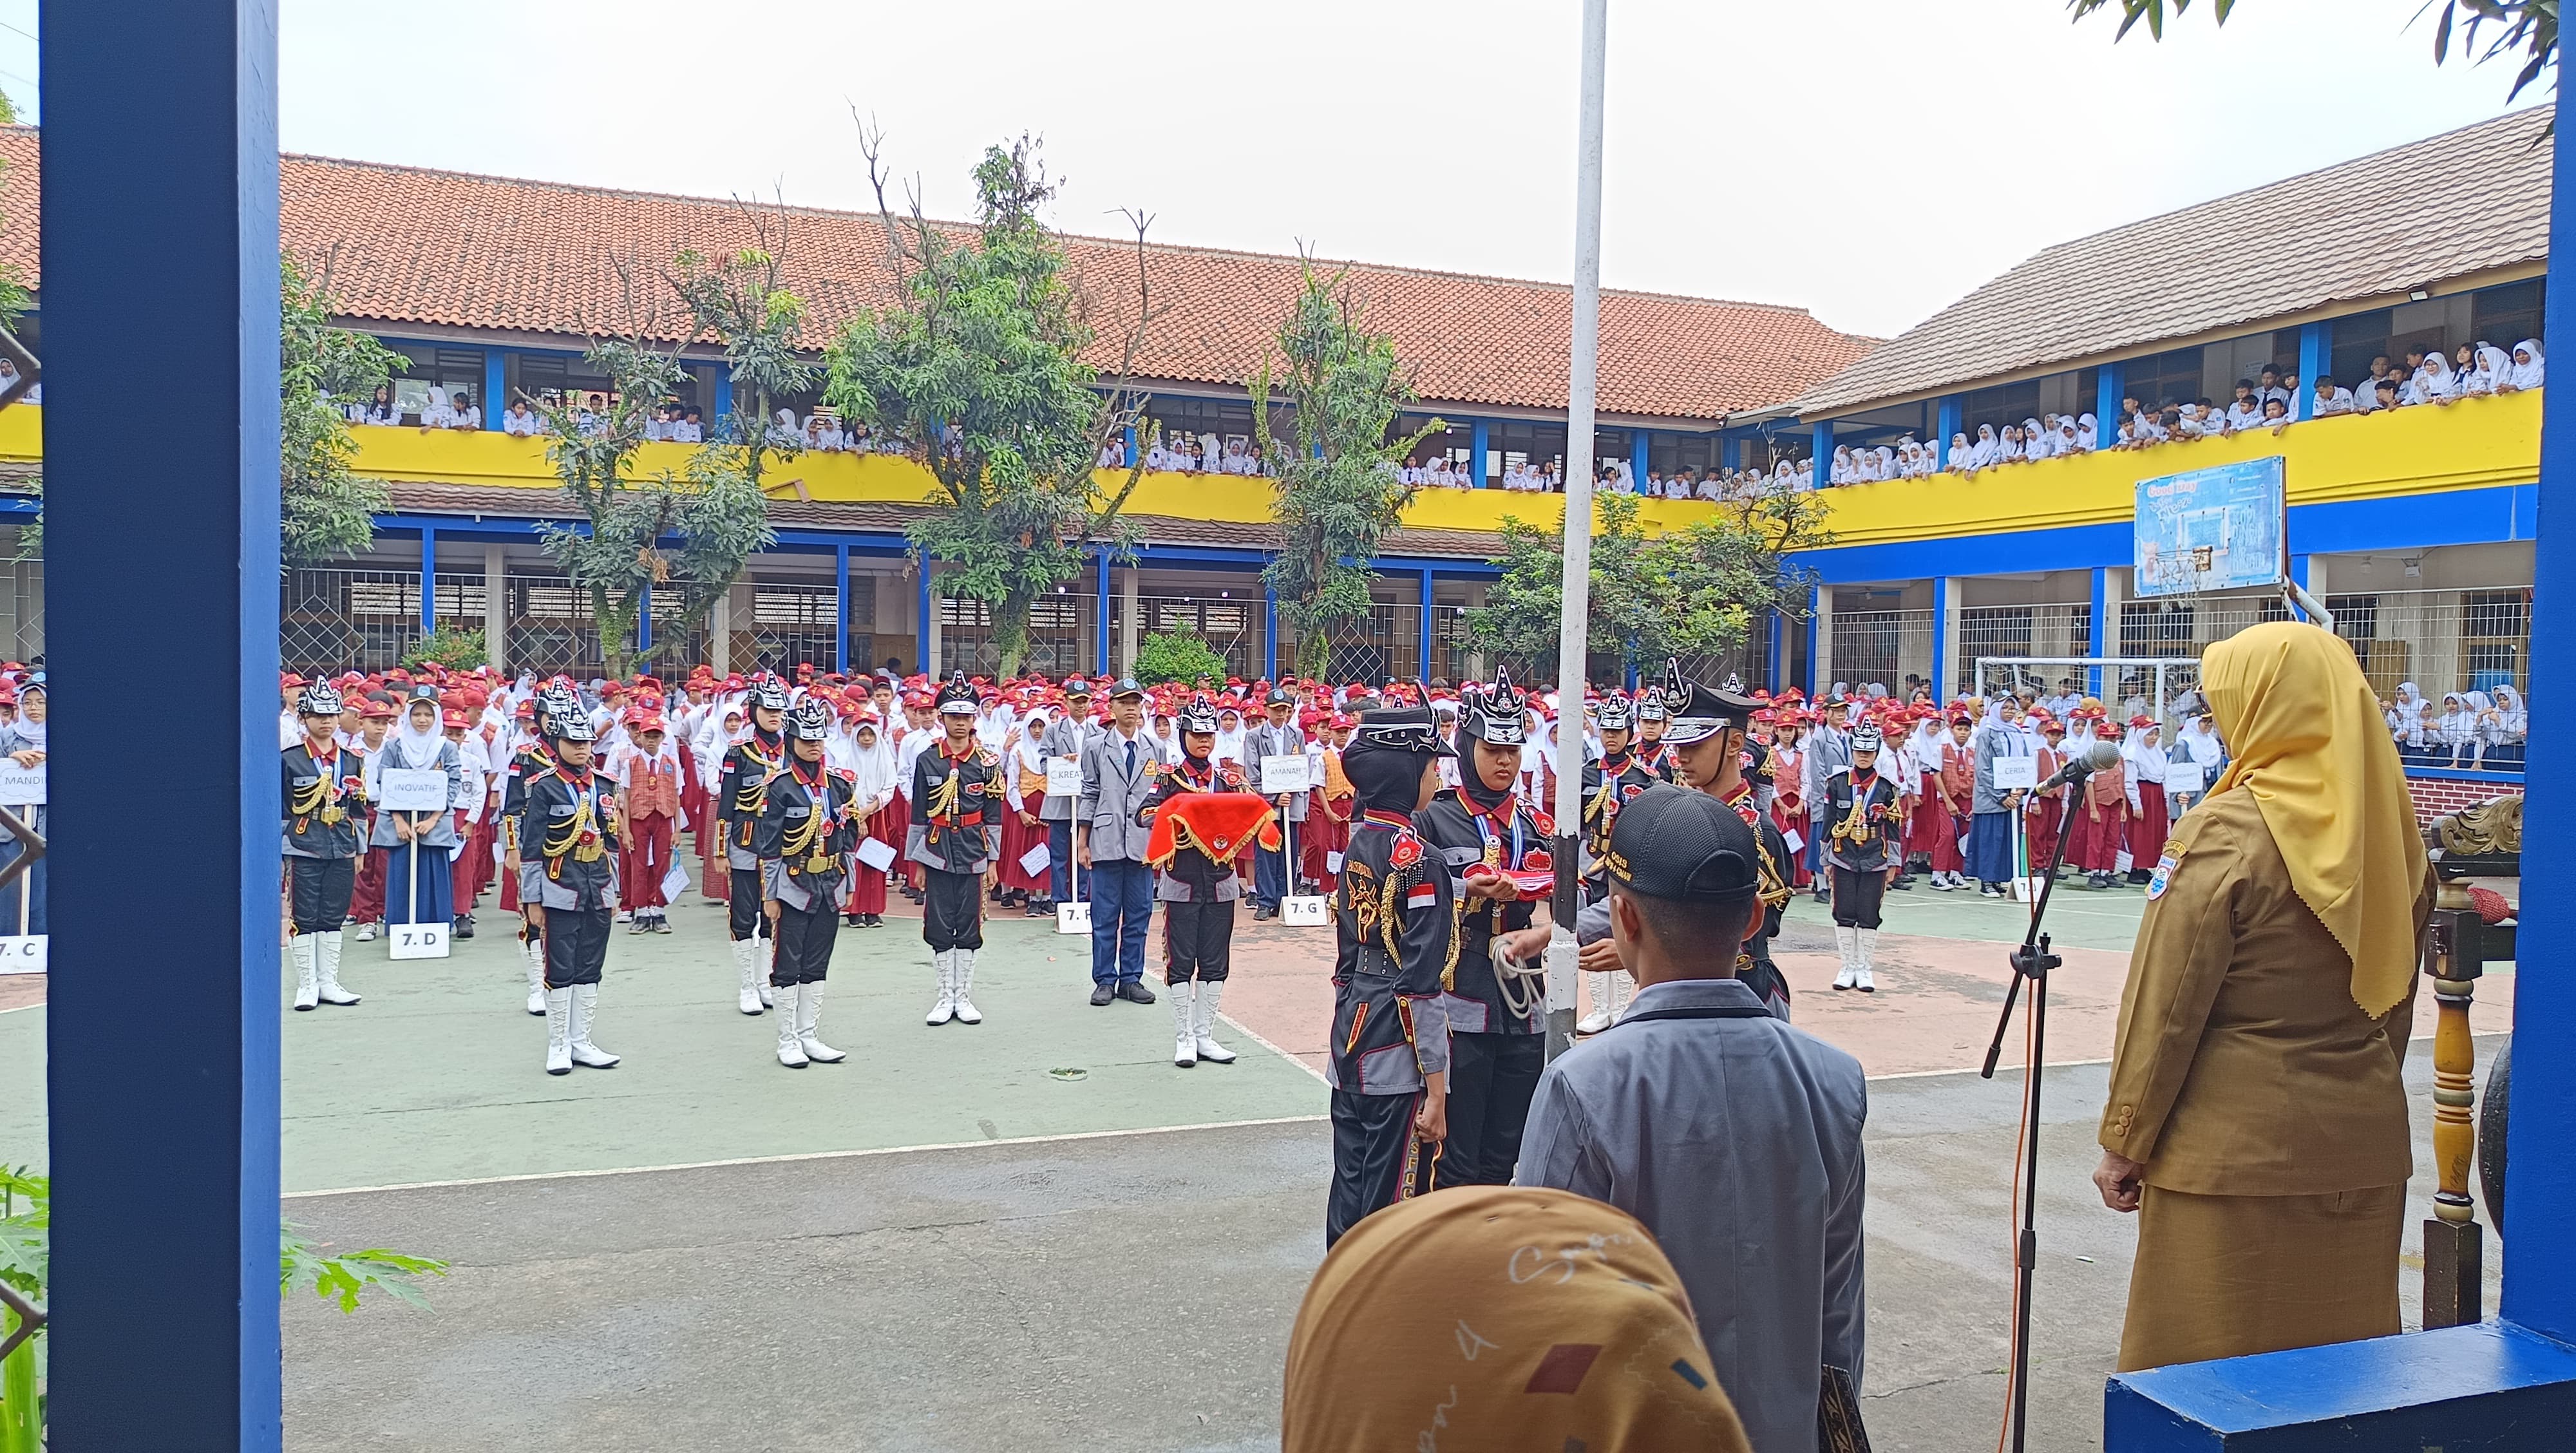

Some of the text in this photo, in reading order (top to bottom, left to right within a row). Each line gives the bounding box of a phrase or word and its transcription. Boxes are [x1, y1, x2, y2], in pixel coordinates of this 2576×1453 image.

[2148, 483, 2174, 497] Good
[1611, 851, 1628, 868] OSIS
[1067, 909, 1079, 920] 7.
[1291, 903, 1317, 913] 7. G
[402, 933, 436, 946] 7. D
[23, 942, 35, 956] C
